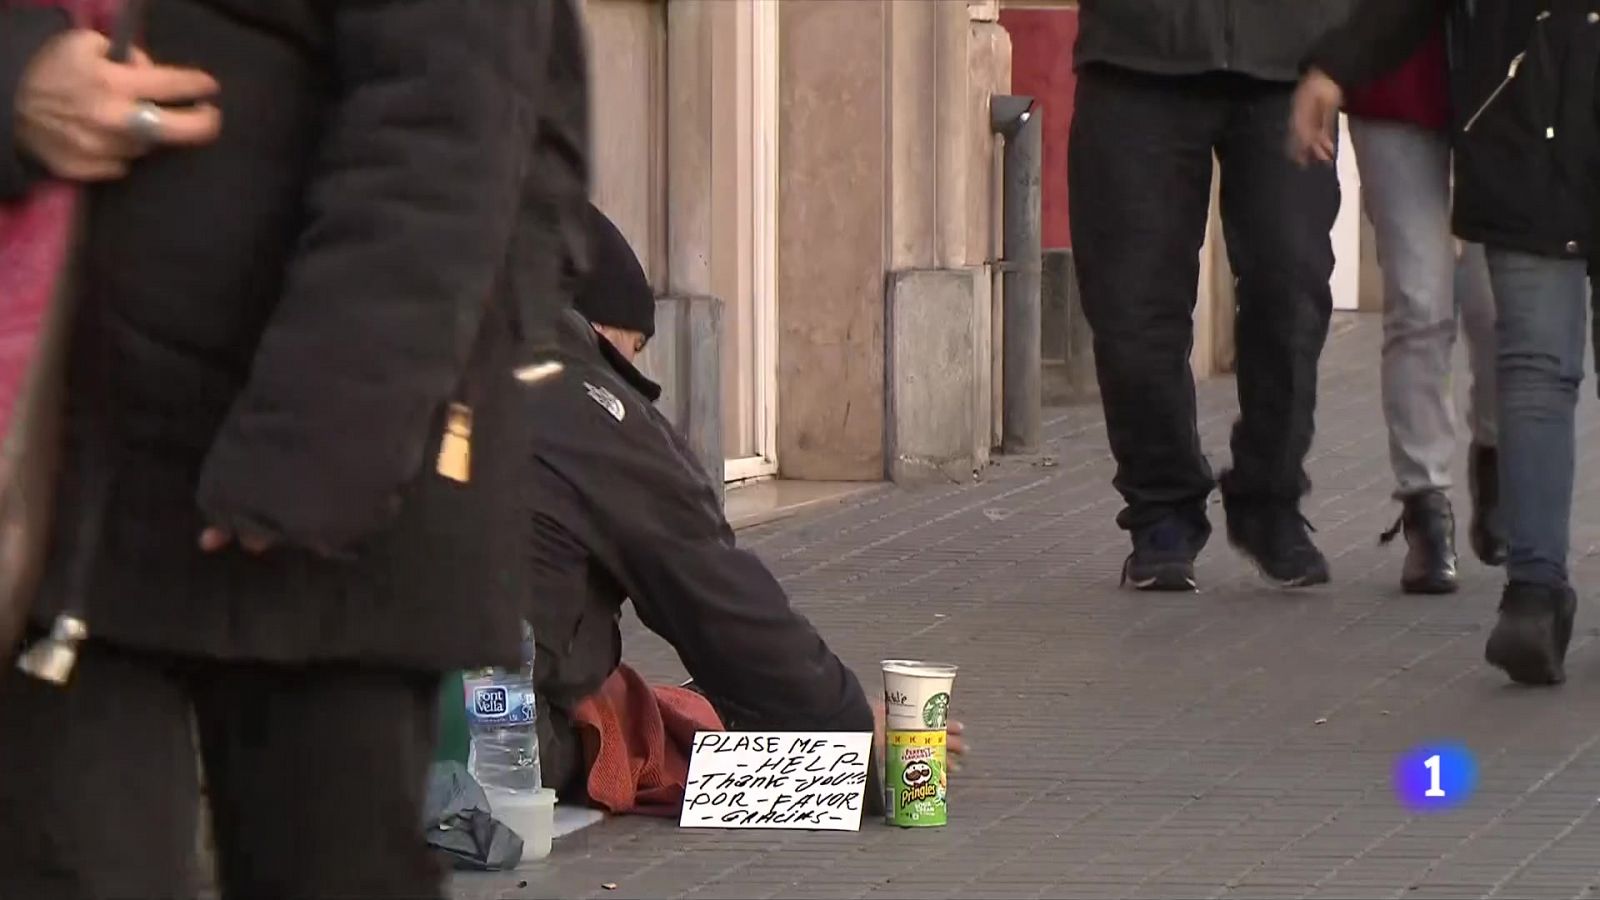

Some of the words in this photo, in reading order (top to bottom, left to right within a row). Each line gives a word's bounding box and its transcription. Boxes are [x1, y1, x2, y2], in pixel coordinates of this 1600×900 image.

[478, 690, 503, 701] Font
[478, 700, 504, 712] Vella
[901, 784, 937, 810] Pringles
